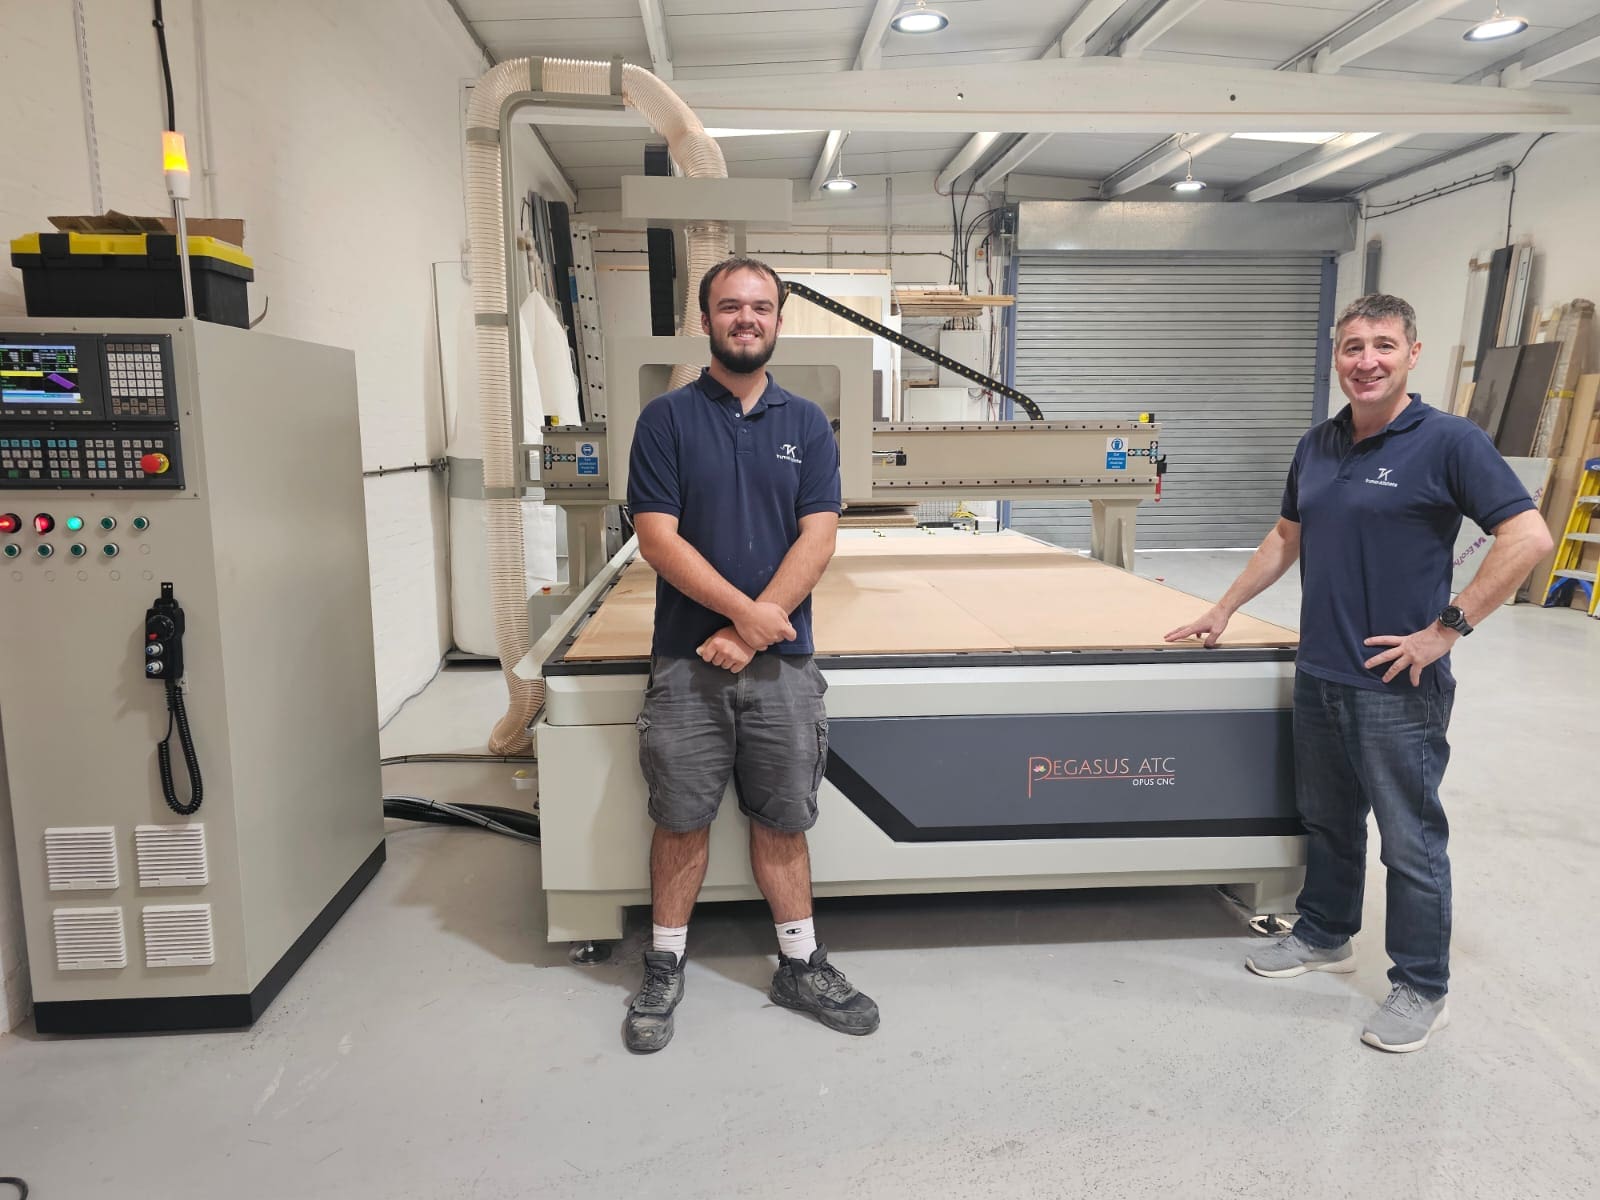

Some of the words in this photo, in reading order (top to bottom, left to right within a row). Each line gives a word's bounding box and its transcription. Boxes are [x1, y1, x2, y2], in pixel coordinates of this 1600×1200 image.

[1453, 545, 1475, 566] EcoTh
[1028, 756, 1130, 799] PEGASUS
[1138, 757, 1176, 774] ATC
[1132, 778, 1154, 786] OPUS
[1156, 777, 1175, 786] CNC
